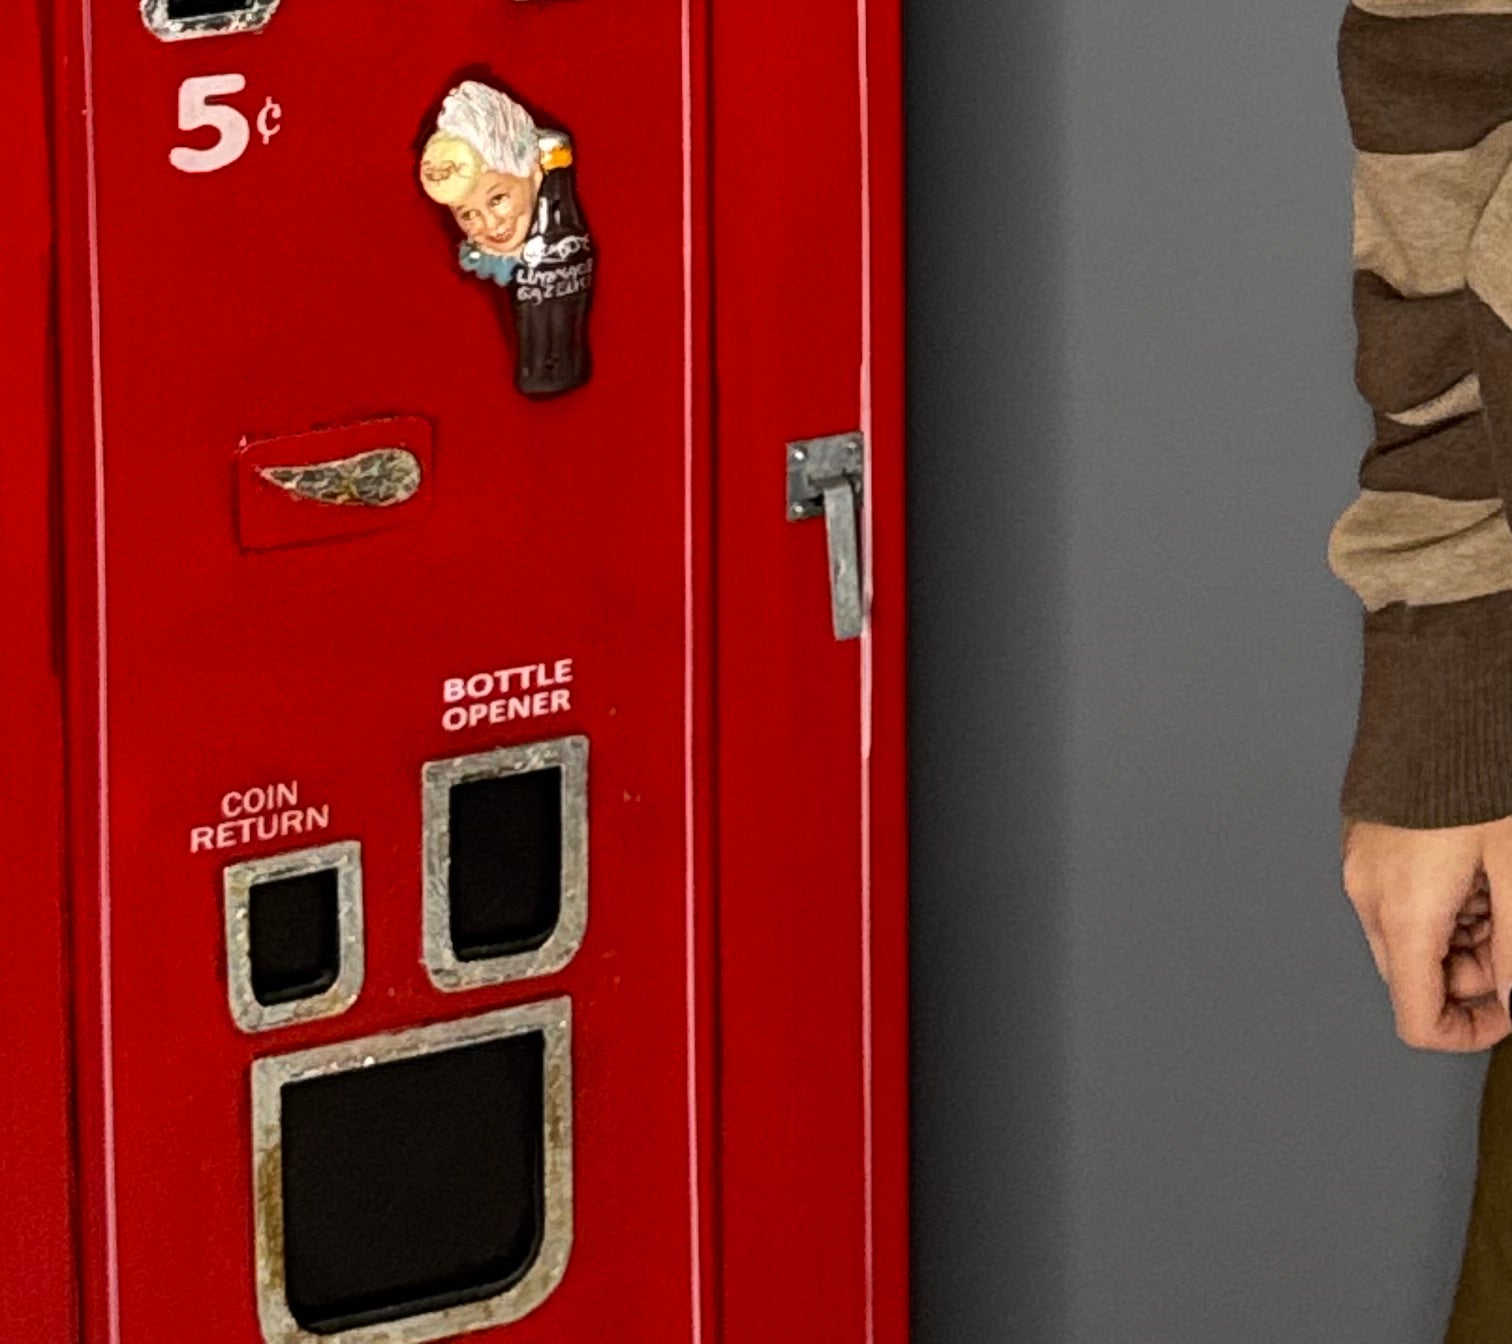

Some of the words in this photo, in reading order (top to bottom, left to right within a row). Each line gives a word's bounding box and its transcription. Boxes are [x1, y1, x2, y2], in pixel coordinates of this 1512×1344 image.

[442, 658, 574, 704] BOTTLE
[441, 688, 572, 732] OPENER
[221, 779, 299, 819] COIN
[190, 803, 330, 854] RETURN
